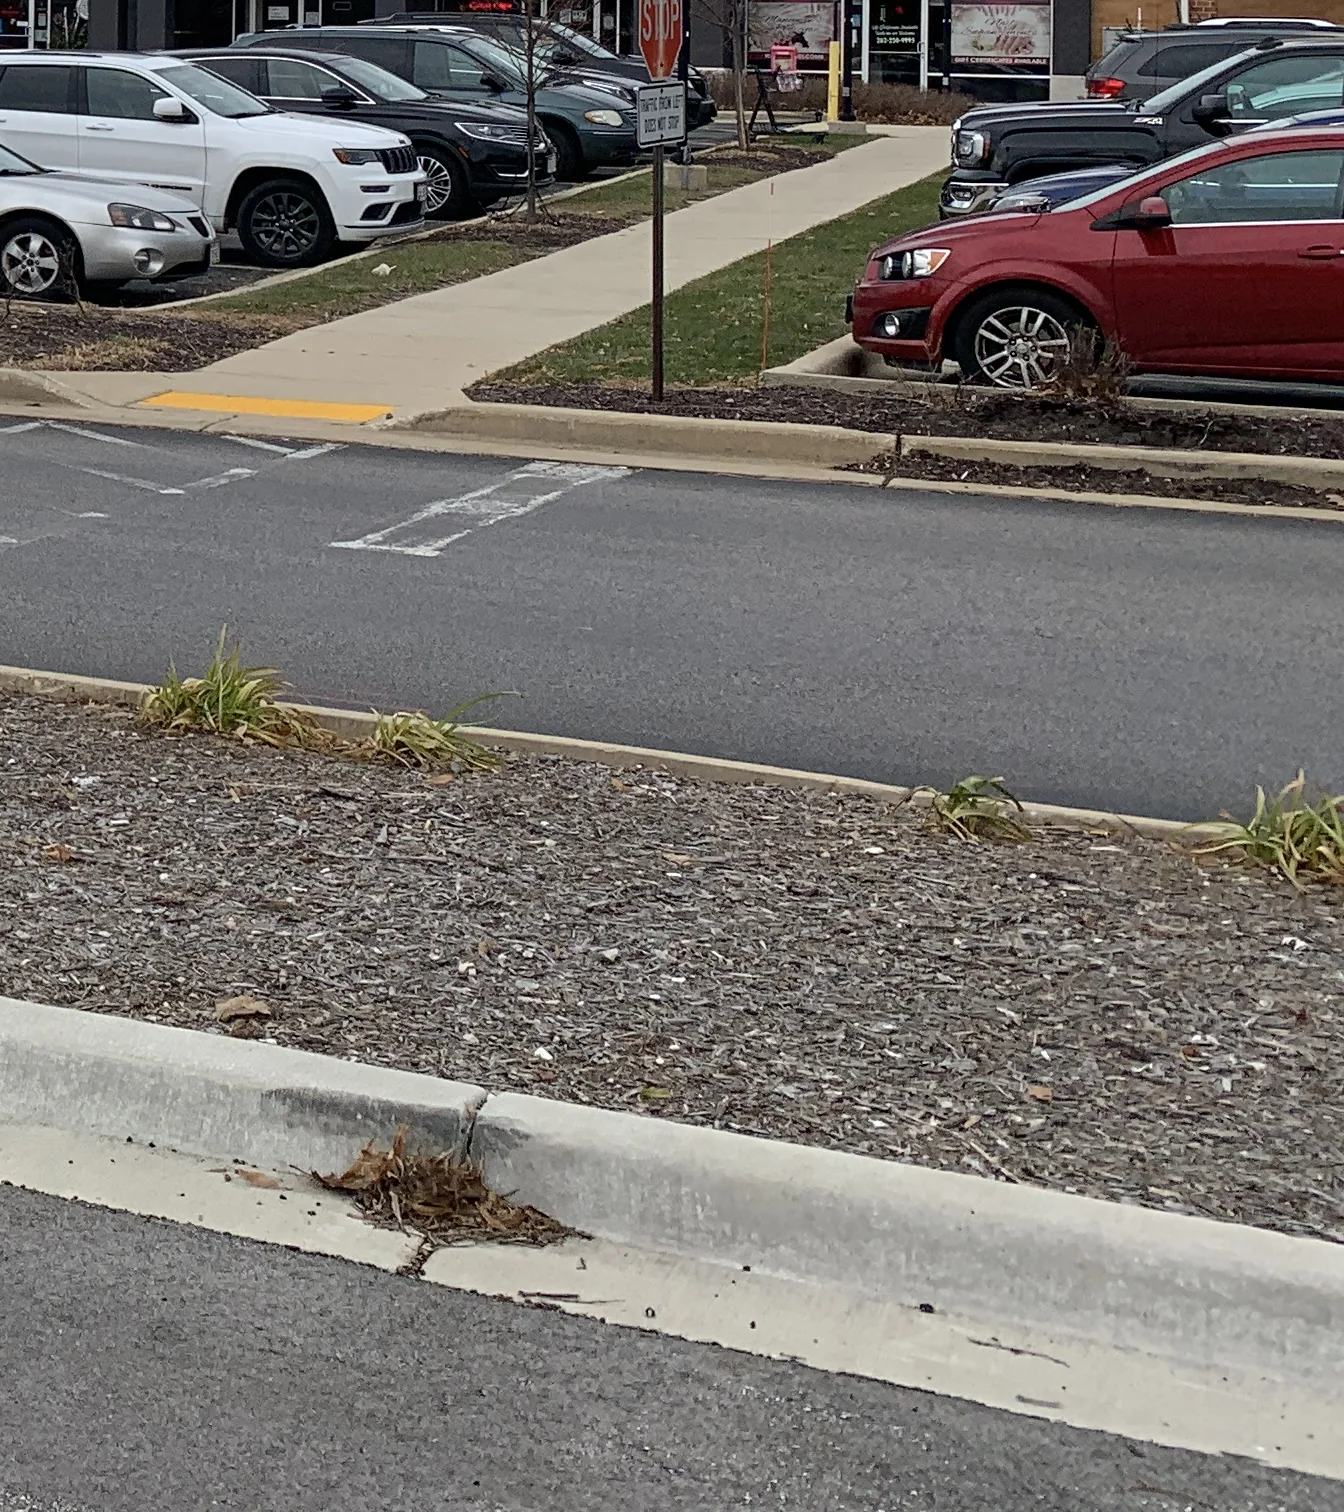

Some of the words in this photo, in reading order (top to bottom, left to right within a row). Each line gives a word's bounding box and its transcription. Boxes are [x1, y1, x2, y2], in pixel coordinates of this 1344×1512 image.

[640, 97, 658, 112] TRAFFIC
[658, 96, 672, 110] FROM
[644, 118, 657, 134] DOES
[657, 117, 667, 131] NOT
[668, 115, 680, 130] STOP
